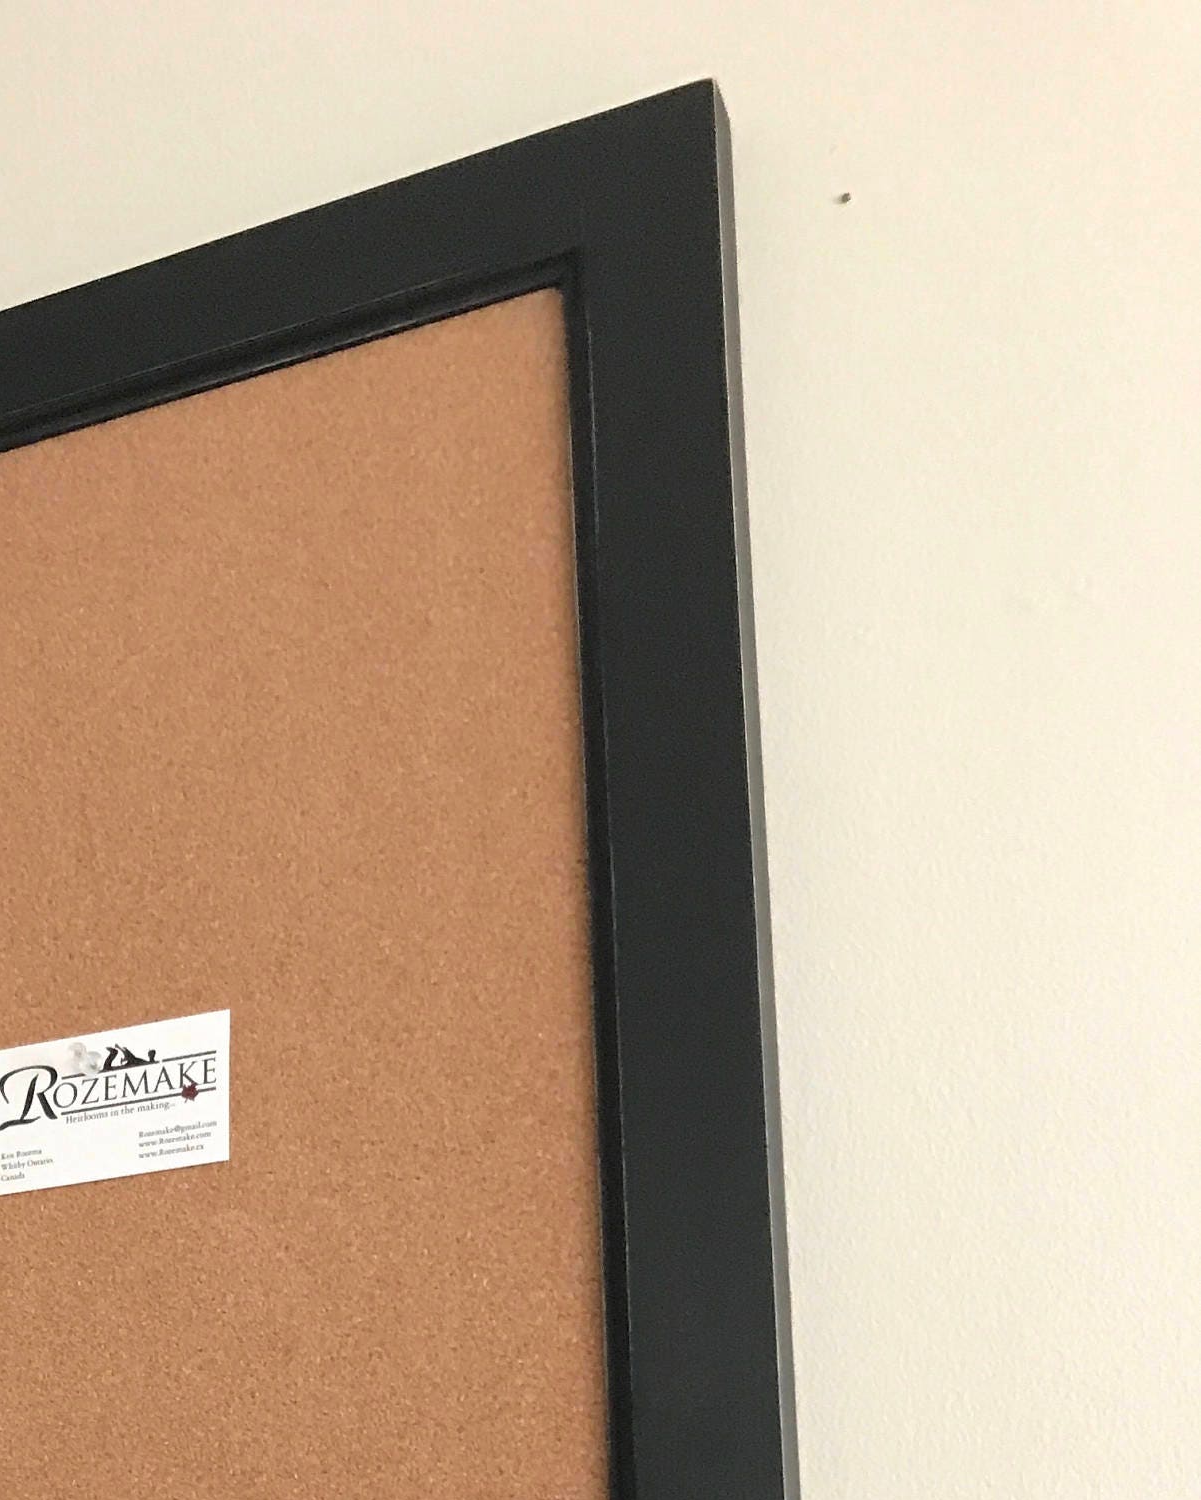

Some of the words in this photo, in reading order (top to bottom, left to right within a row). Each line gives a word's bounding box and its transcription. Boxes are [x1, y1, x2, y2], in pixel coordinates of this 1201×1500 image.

[65, 1108, 109, 1125] Heirlooms
[110, 1109, 120, 1119] in
[120, 1105, 136, 1116] the
